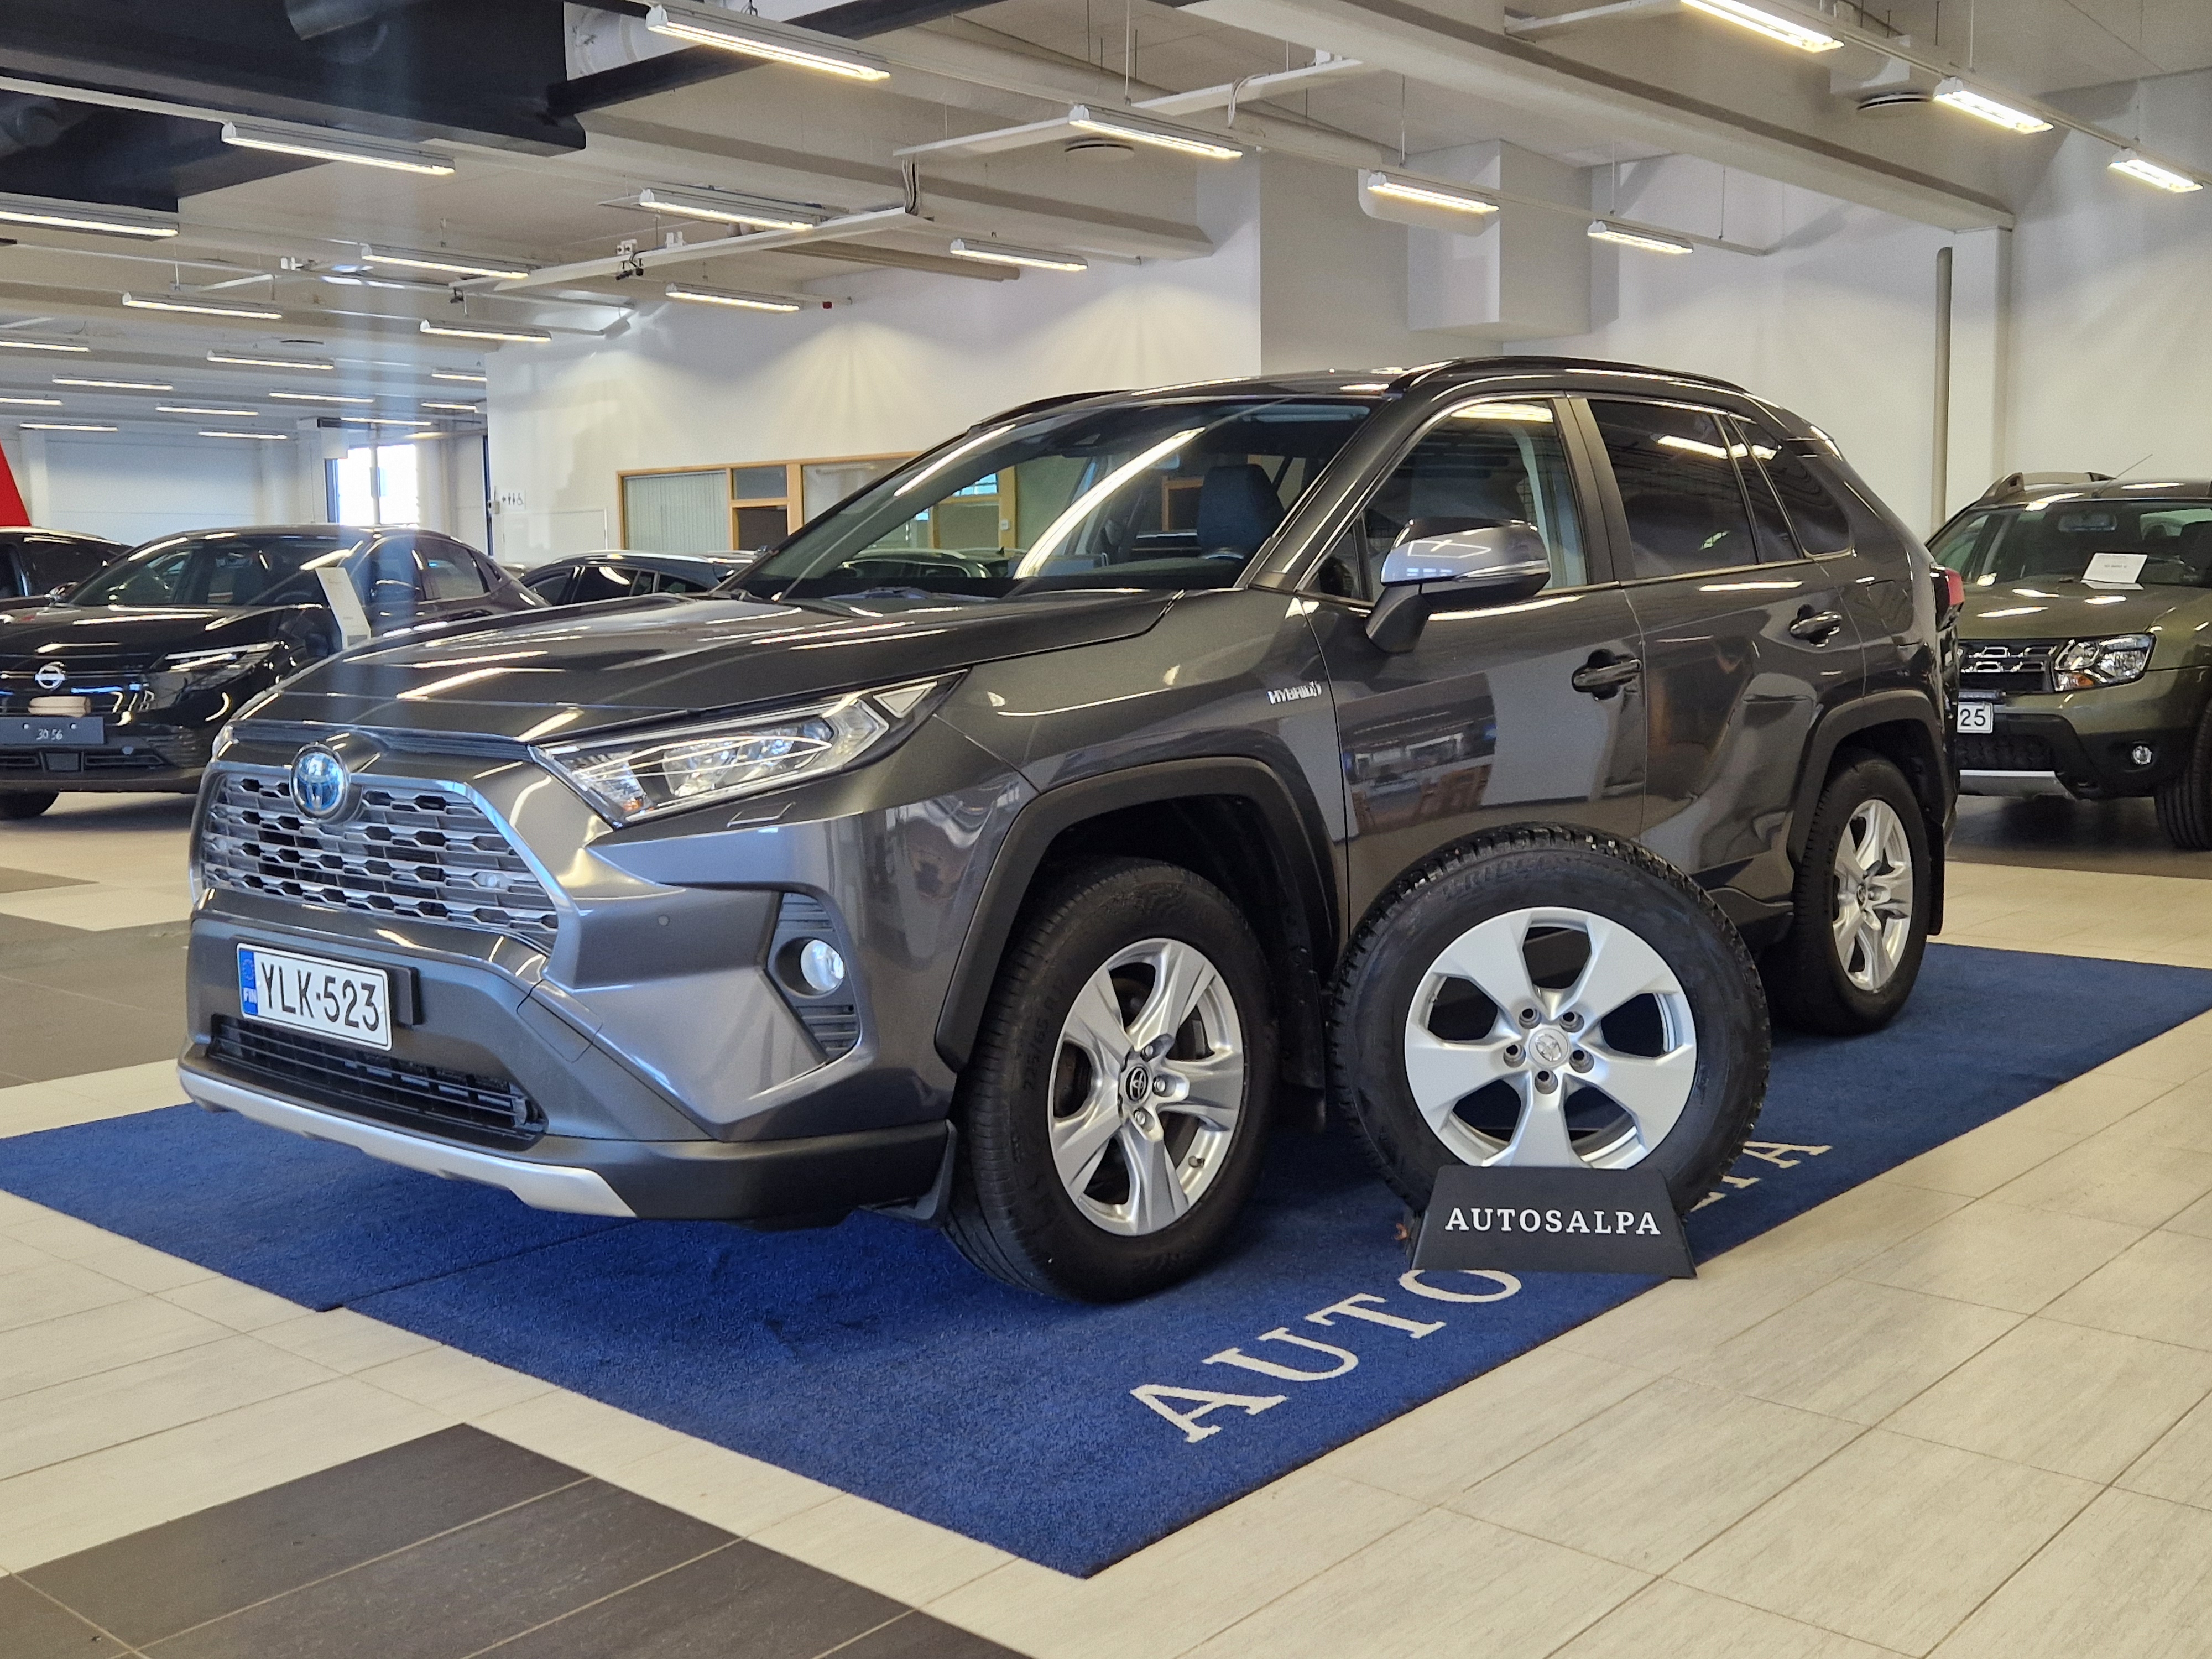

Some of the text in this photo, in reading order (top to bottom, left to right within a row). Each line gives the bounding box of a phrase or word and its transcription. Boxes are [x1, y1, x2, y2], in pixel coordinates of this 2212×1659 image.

[1960, 708, 1986, 727] 25
[243, 987, 257, 1004] FIN
[1444, 1207, 1661, 1235] AUTOSALPA
